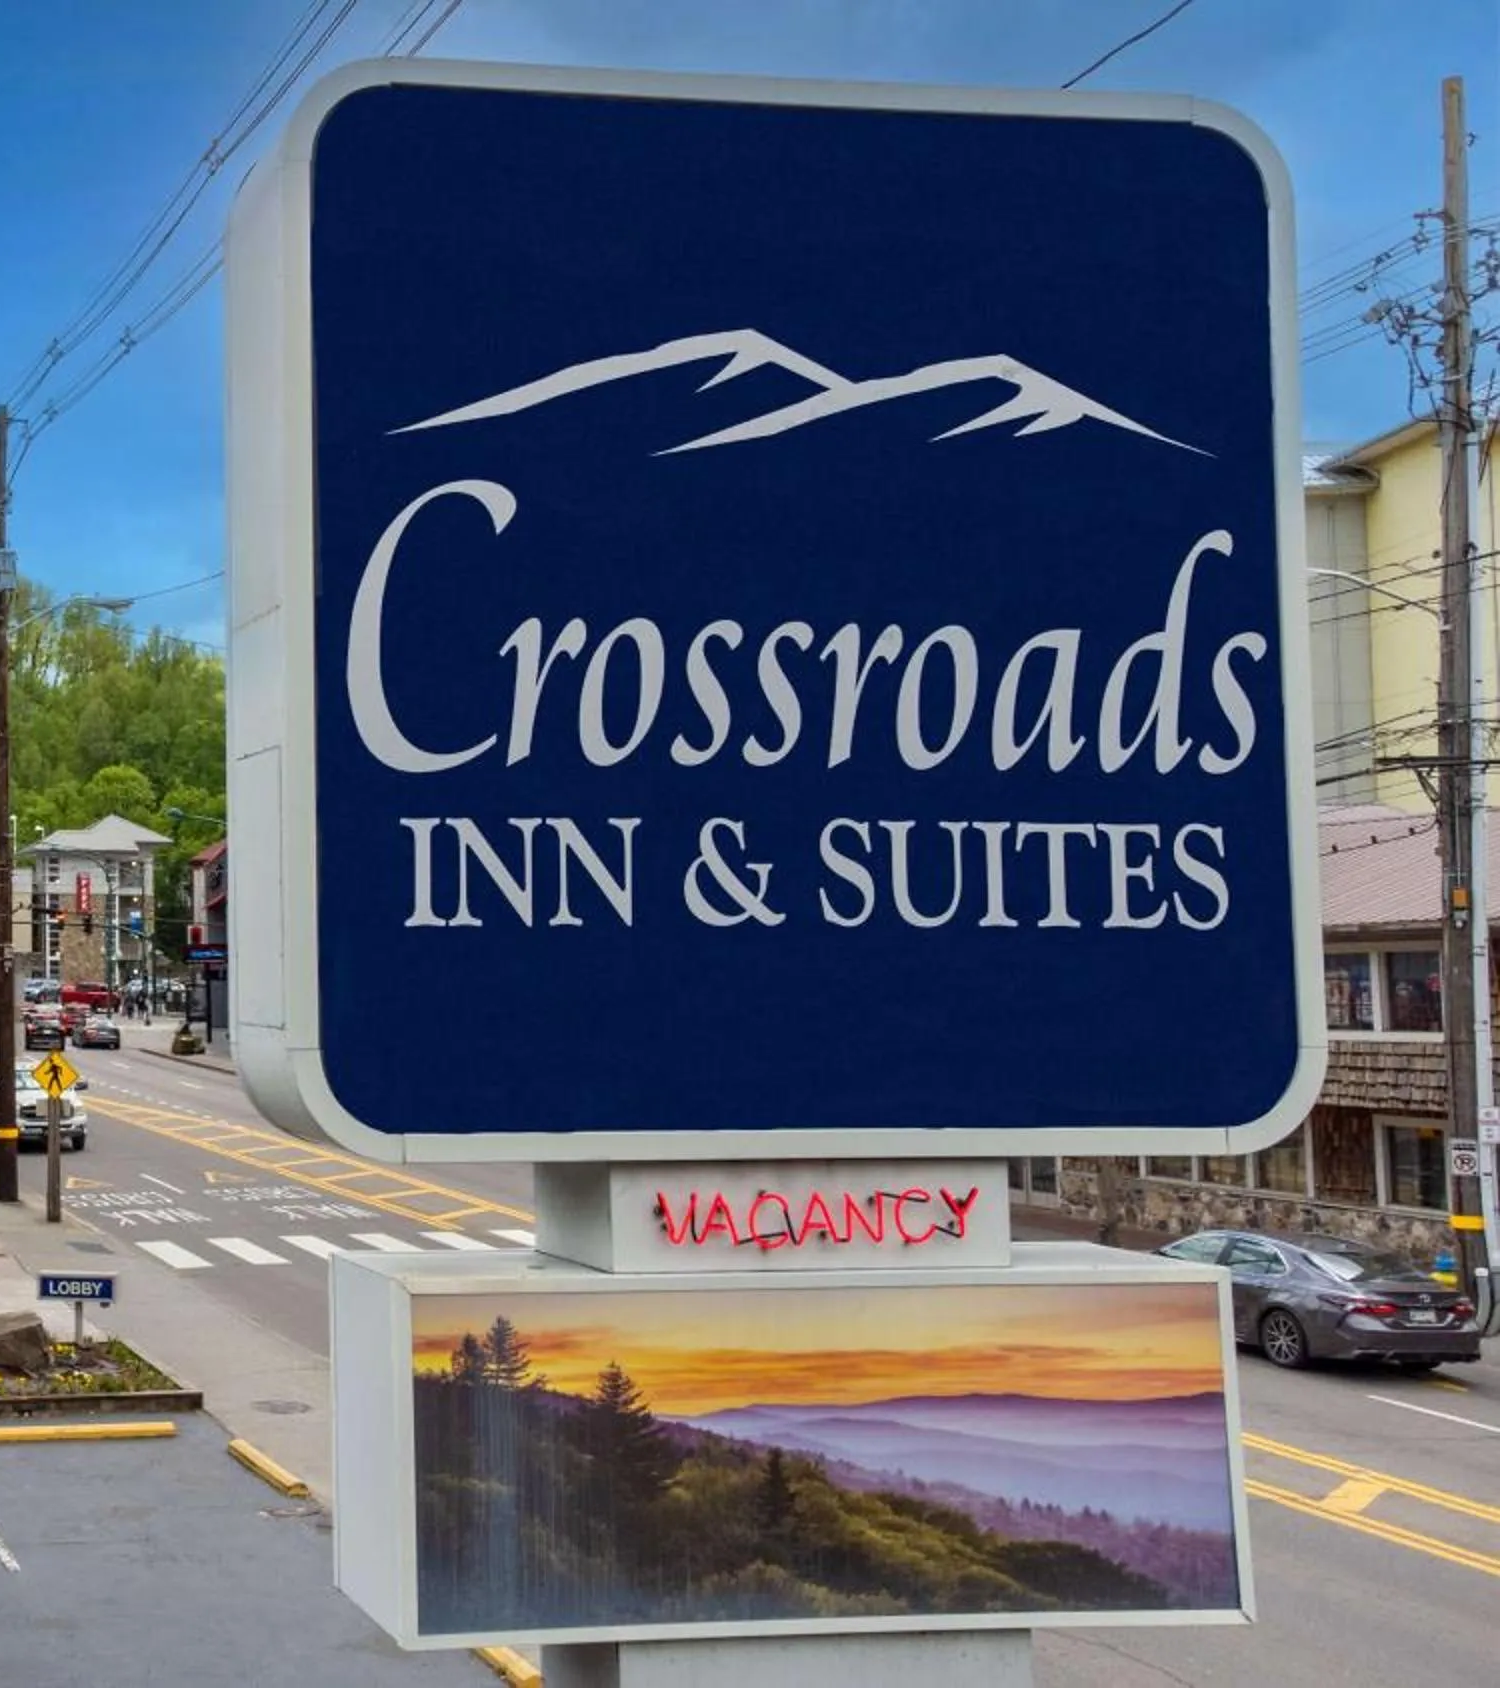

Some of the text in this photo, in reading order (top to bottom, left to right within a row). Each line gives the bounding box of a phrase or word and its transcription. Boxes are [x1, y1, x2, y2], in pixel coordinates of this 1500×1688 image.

[346, 479, 1268, 775] Crossroads
[400, 817, 1229, 931] INN & SUITES
[99, 1207, 212, 1227] WALK
[656, 1186, 980, 1250] VACANCY
[49, 1281, 103, 1296] LOBBY
